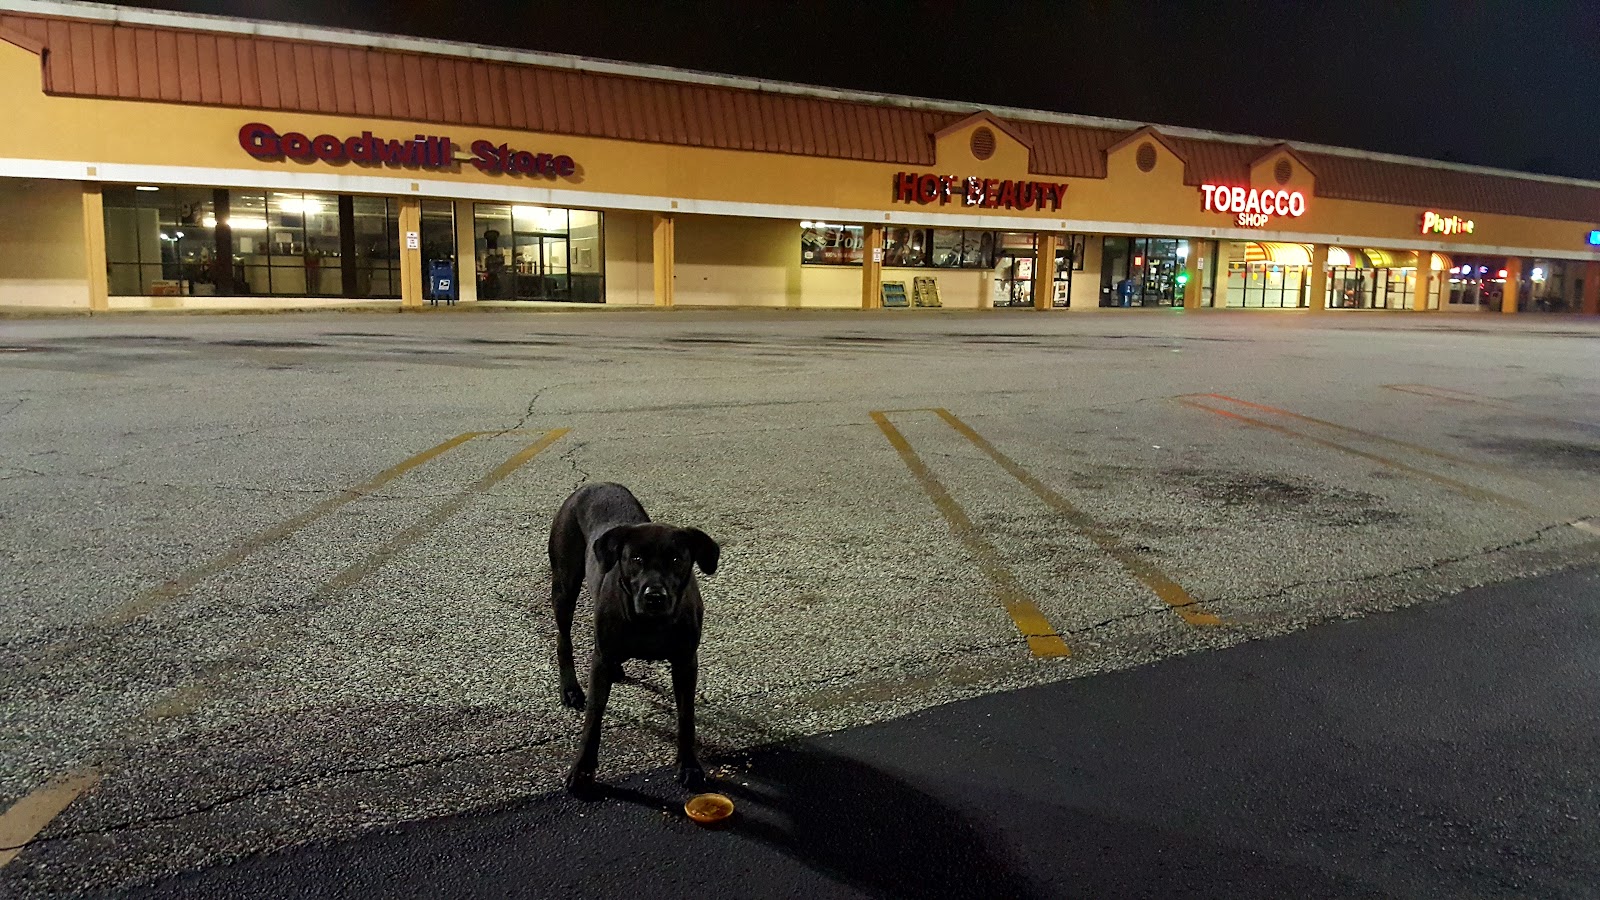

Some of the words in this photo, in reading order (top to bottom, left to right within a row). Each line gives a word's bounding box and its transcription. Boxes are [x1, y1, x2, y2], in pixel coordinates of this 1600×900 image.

[238, 122, 452, 167] Goodwill
[471, 139, 576, 177] Store
[896, 171, 958, 204] HOT
[966, 175, 1069, 209] BEAUTY
[1201, 184, 1306, 217] TOBACCO
[1238, 213, 1269, 227] SHOP
